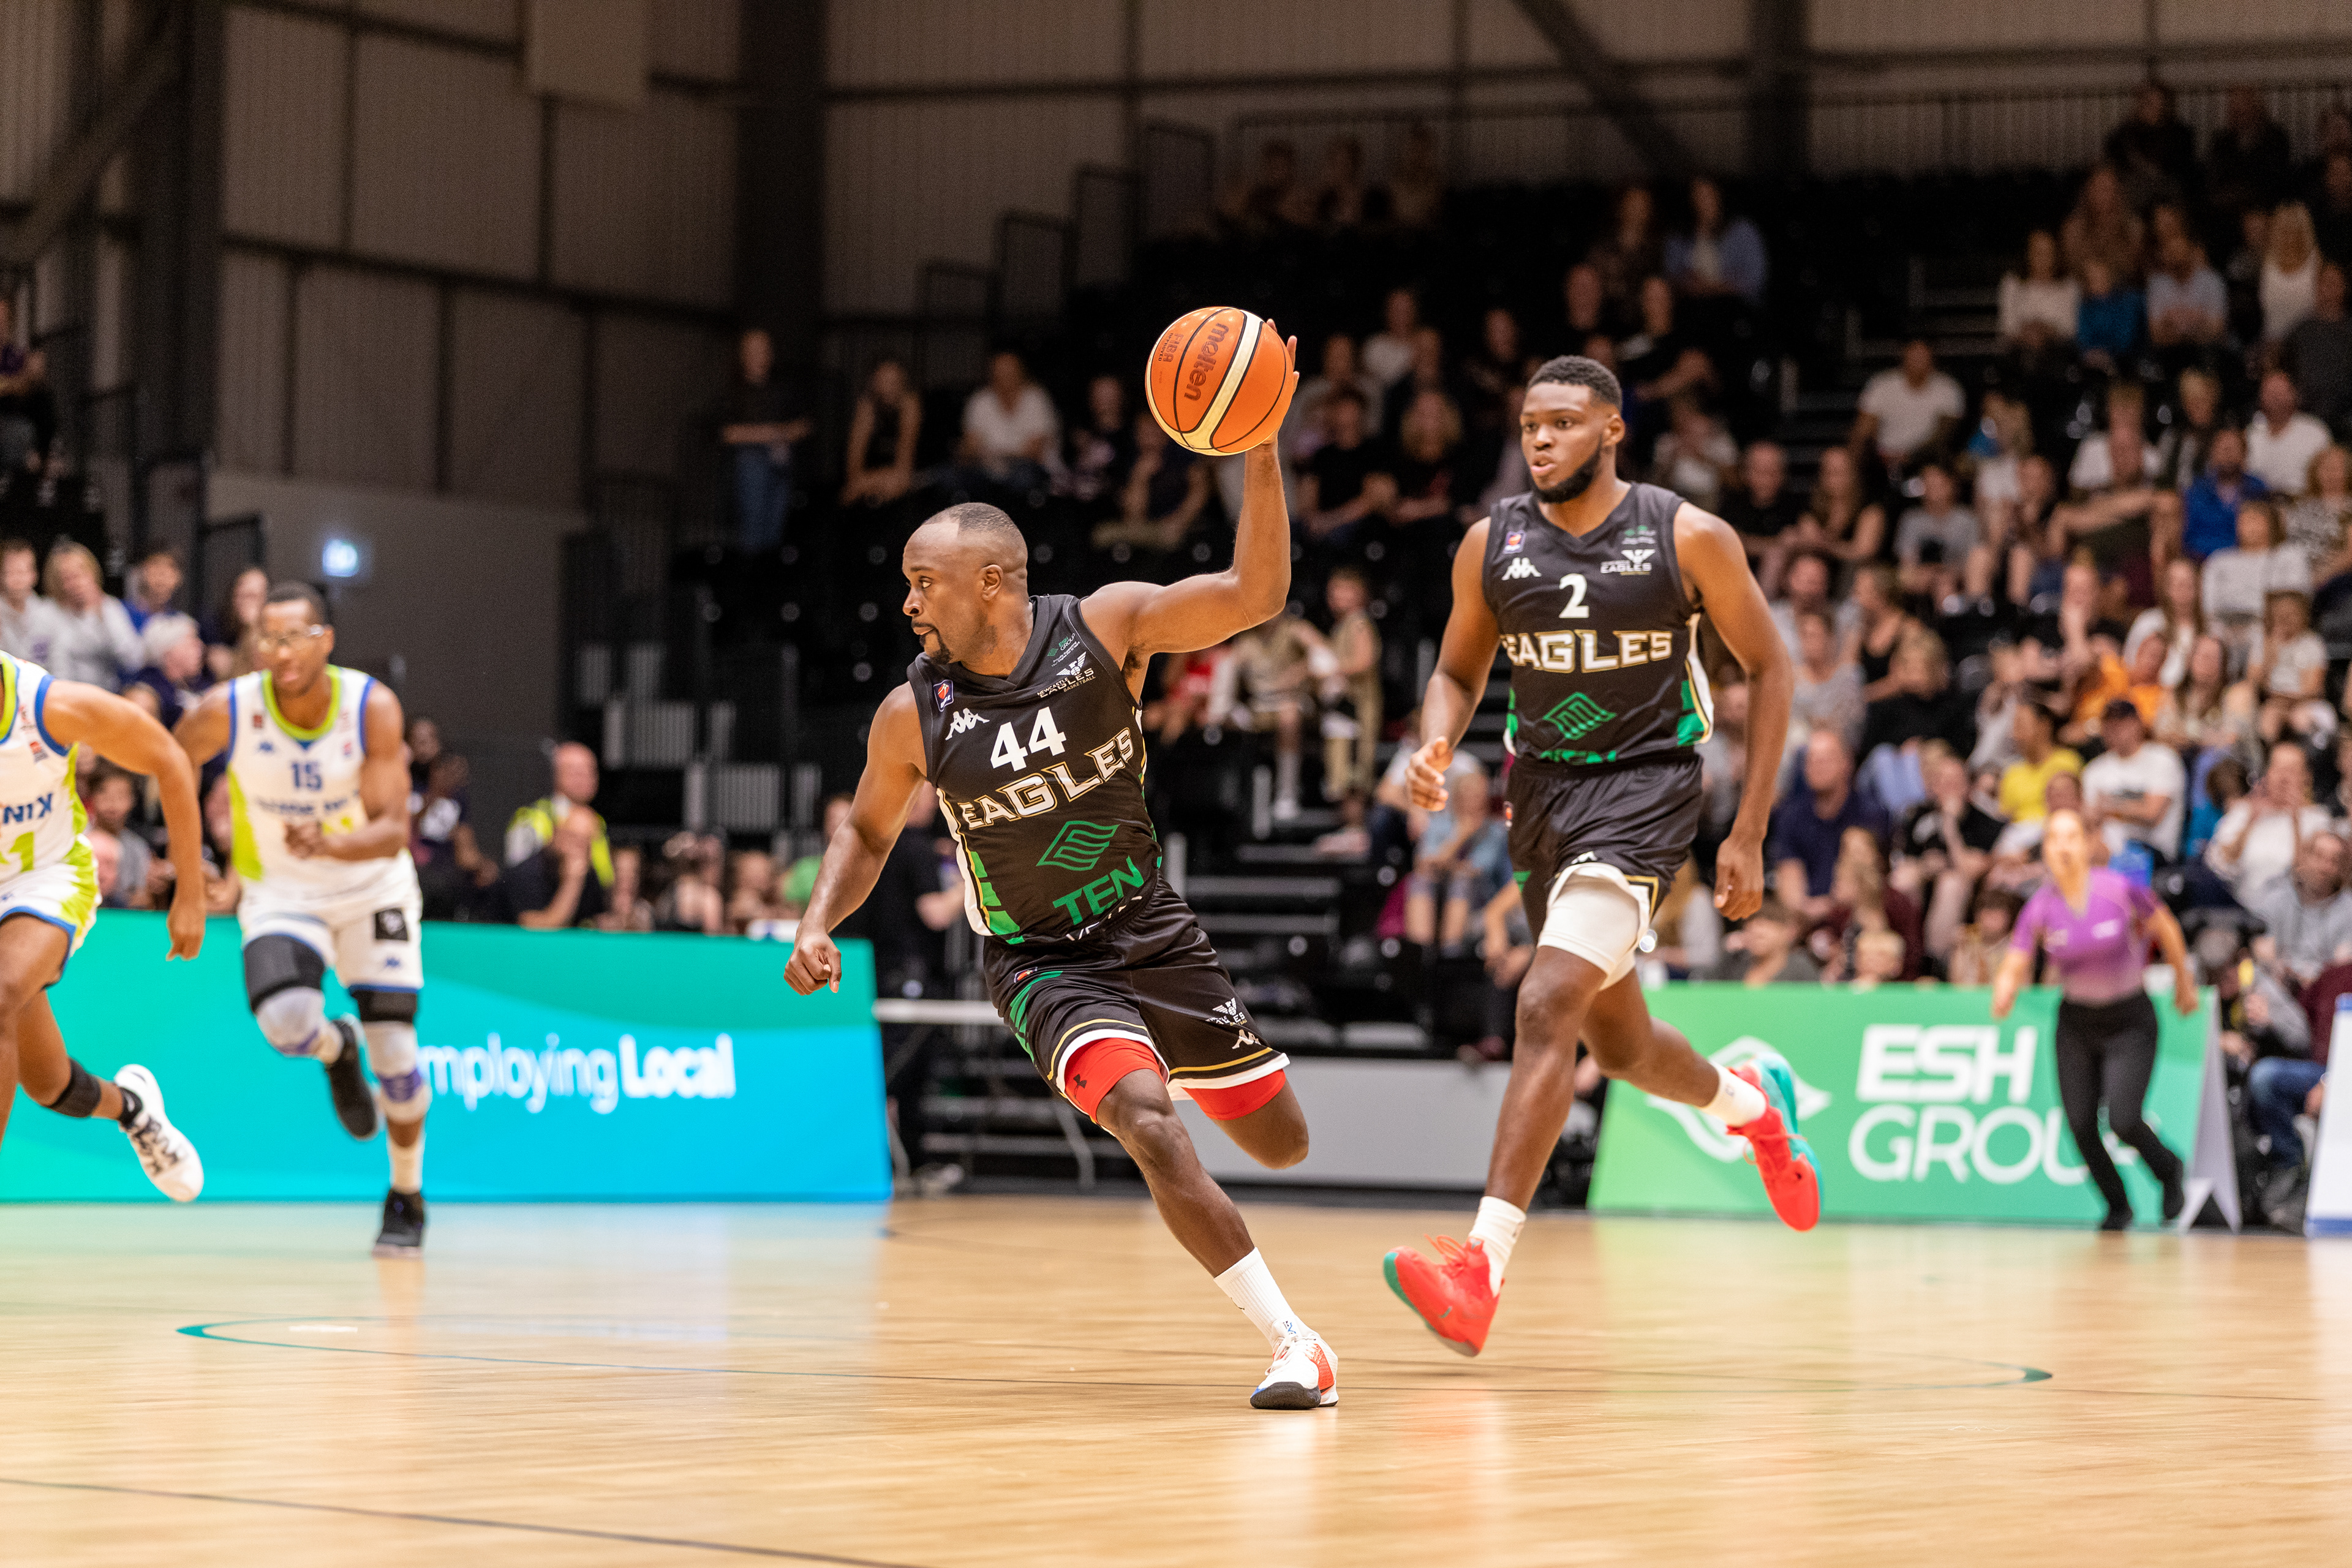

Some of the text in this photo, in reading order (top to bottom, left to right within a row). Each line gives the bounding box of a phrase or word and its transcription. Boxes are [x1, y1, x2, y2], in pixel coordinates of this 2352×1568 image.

[1163, 333, 1184, 363] FIBA
[1184, 322, 1230, 402] molten
[1558, 573, 1590, 619] 2
[1060, 633, 1076, 651] GROUP
[1500, 629, 1673, 674] EAGLES
[1037, 677, 1069, 696] NEWCASTLE
[1063, 674, 1096, 693] BASKETBALL
[990, 706, 1067, 772] 44
[290, 760, 323, 791] 15
[957, 727, 1134, 830] EAGLES
[1052, 855, 1145, 925] TEN
[417, 1031, 737, 1115] mploying Local
[1855, 1023, 2038, 1104] ESH
[1847, 1104, 2144, 1186] GROU
